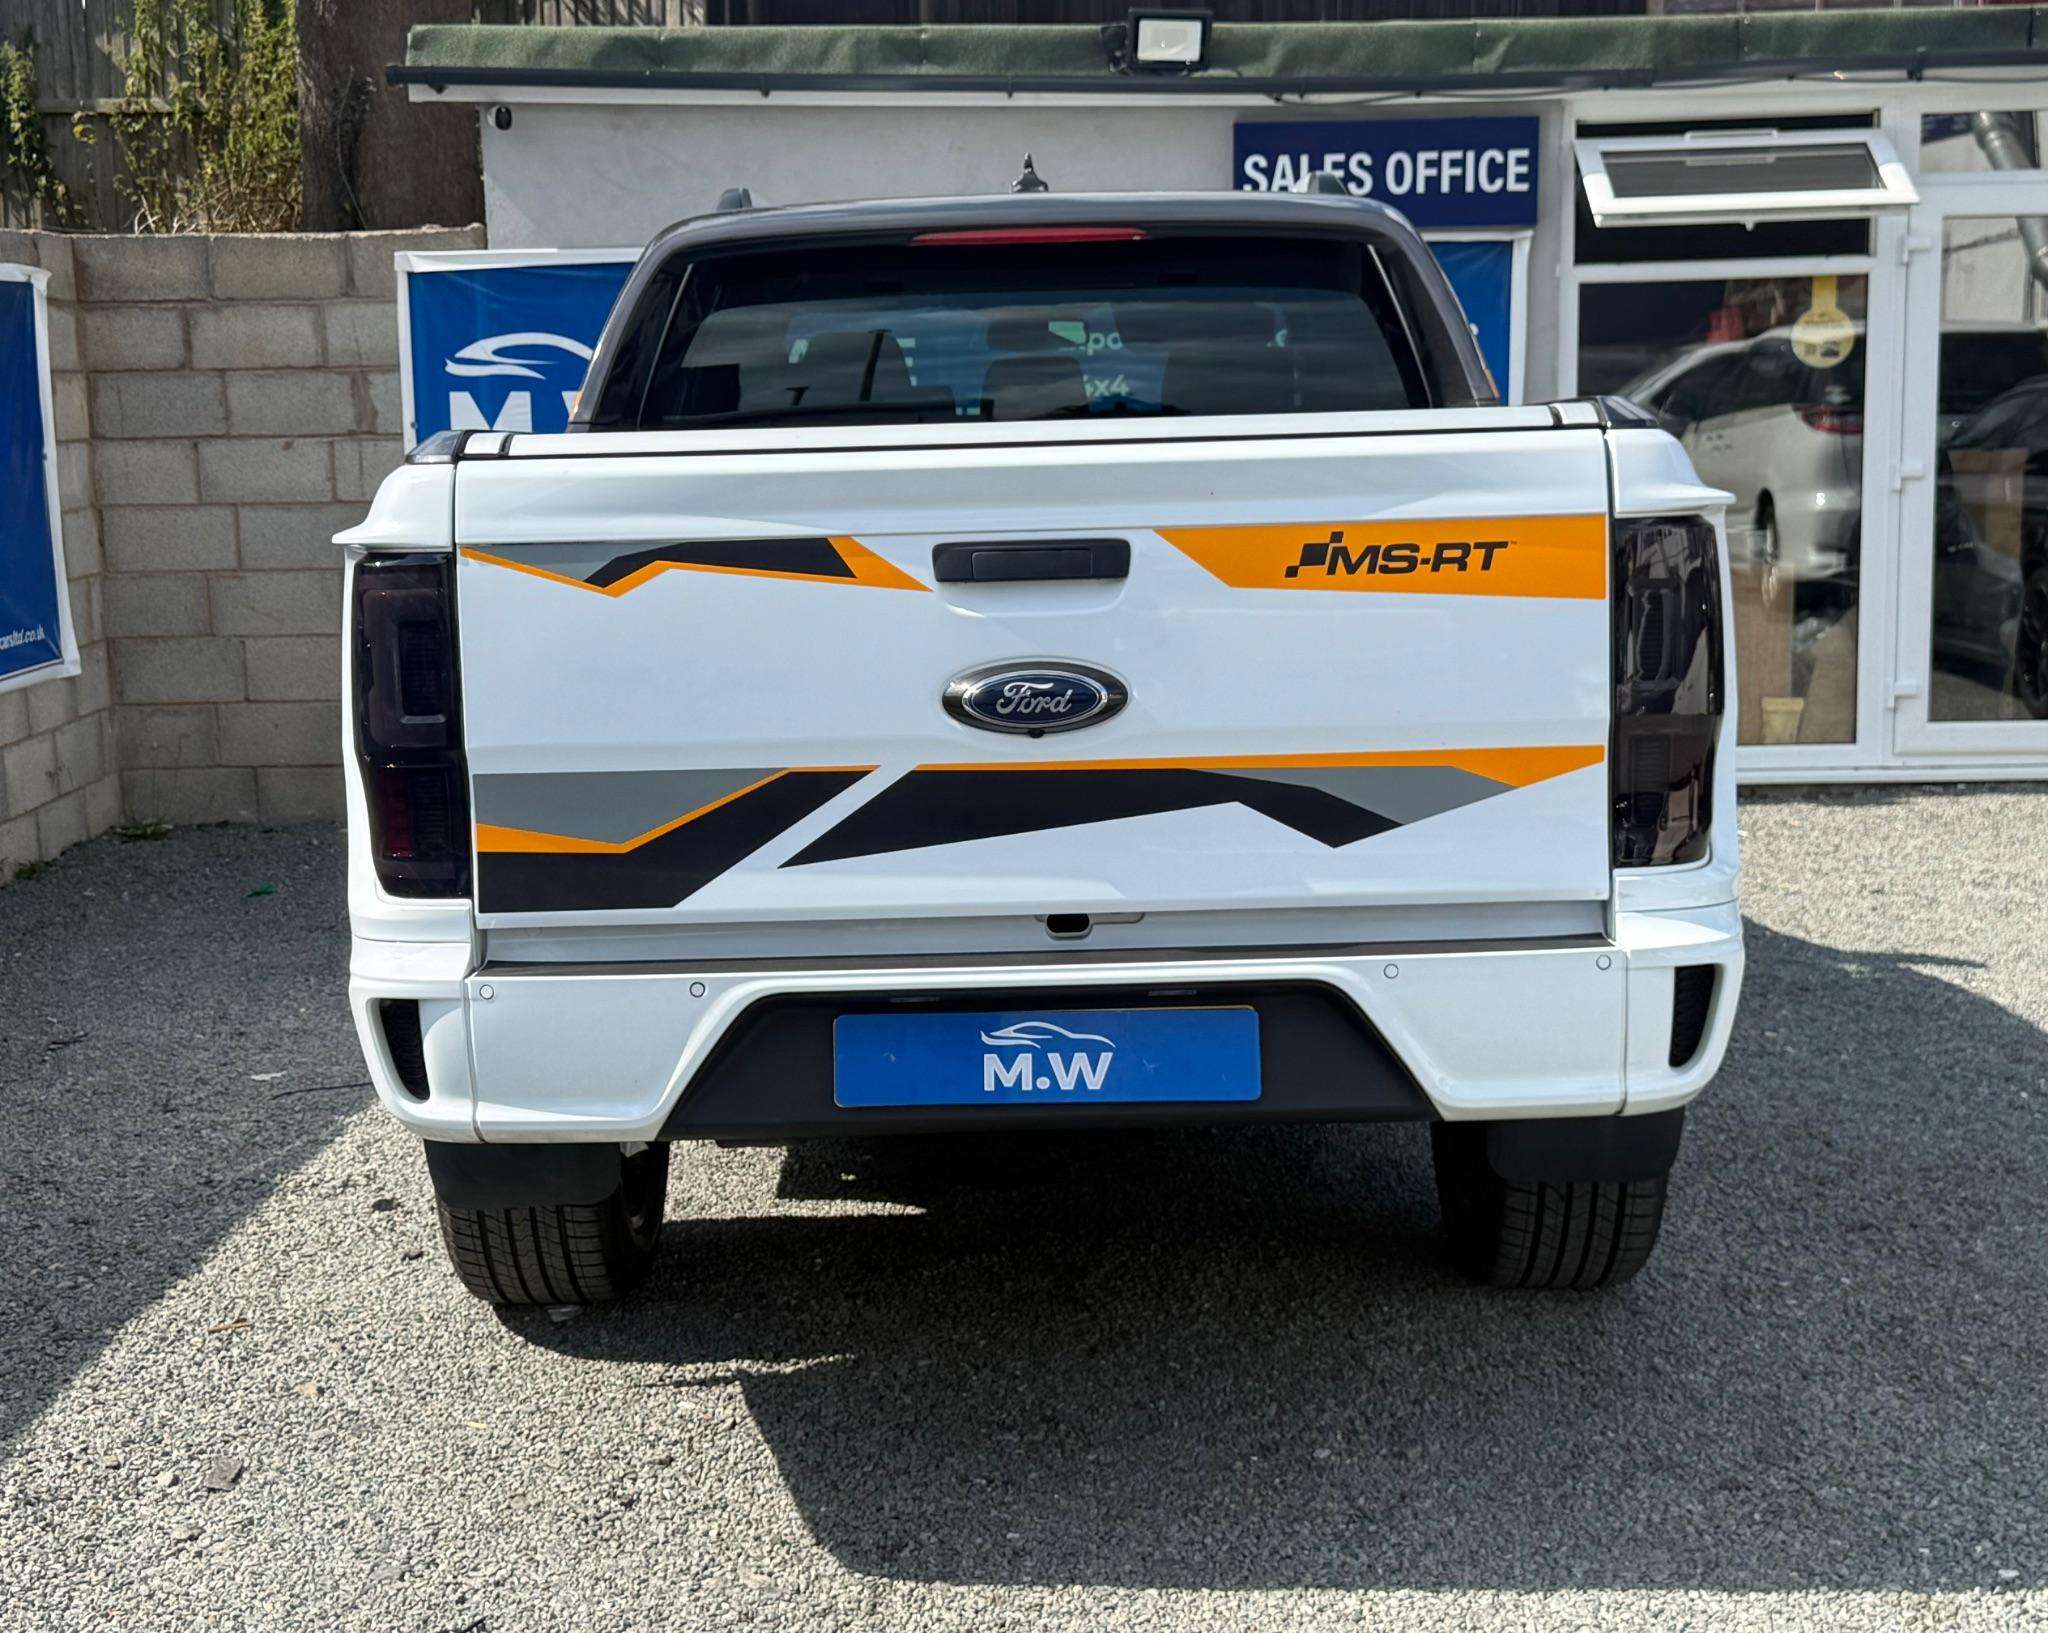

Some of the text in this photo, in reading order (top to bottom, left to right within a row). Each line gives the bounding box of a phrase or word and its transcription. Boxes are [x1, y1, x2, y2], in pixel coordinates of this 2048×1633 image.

[1385, 148, 1530, 195] OFFICE
[996, 681, 1074, 714] Ford
[983, 1052, 1114, 1091] M.W
